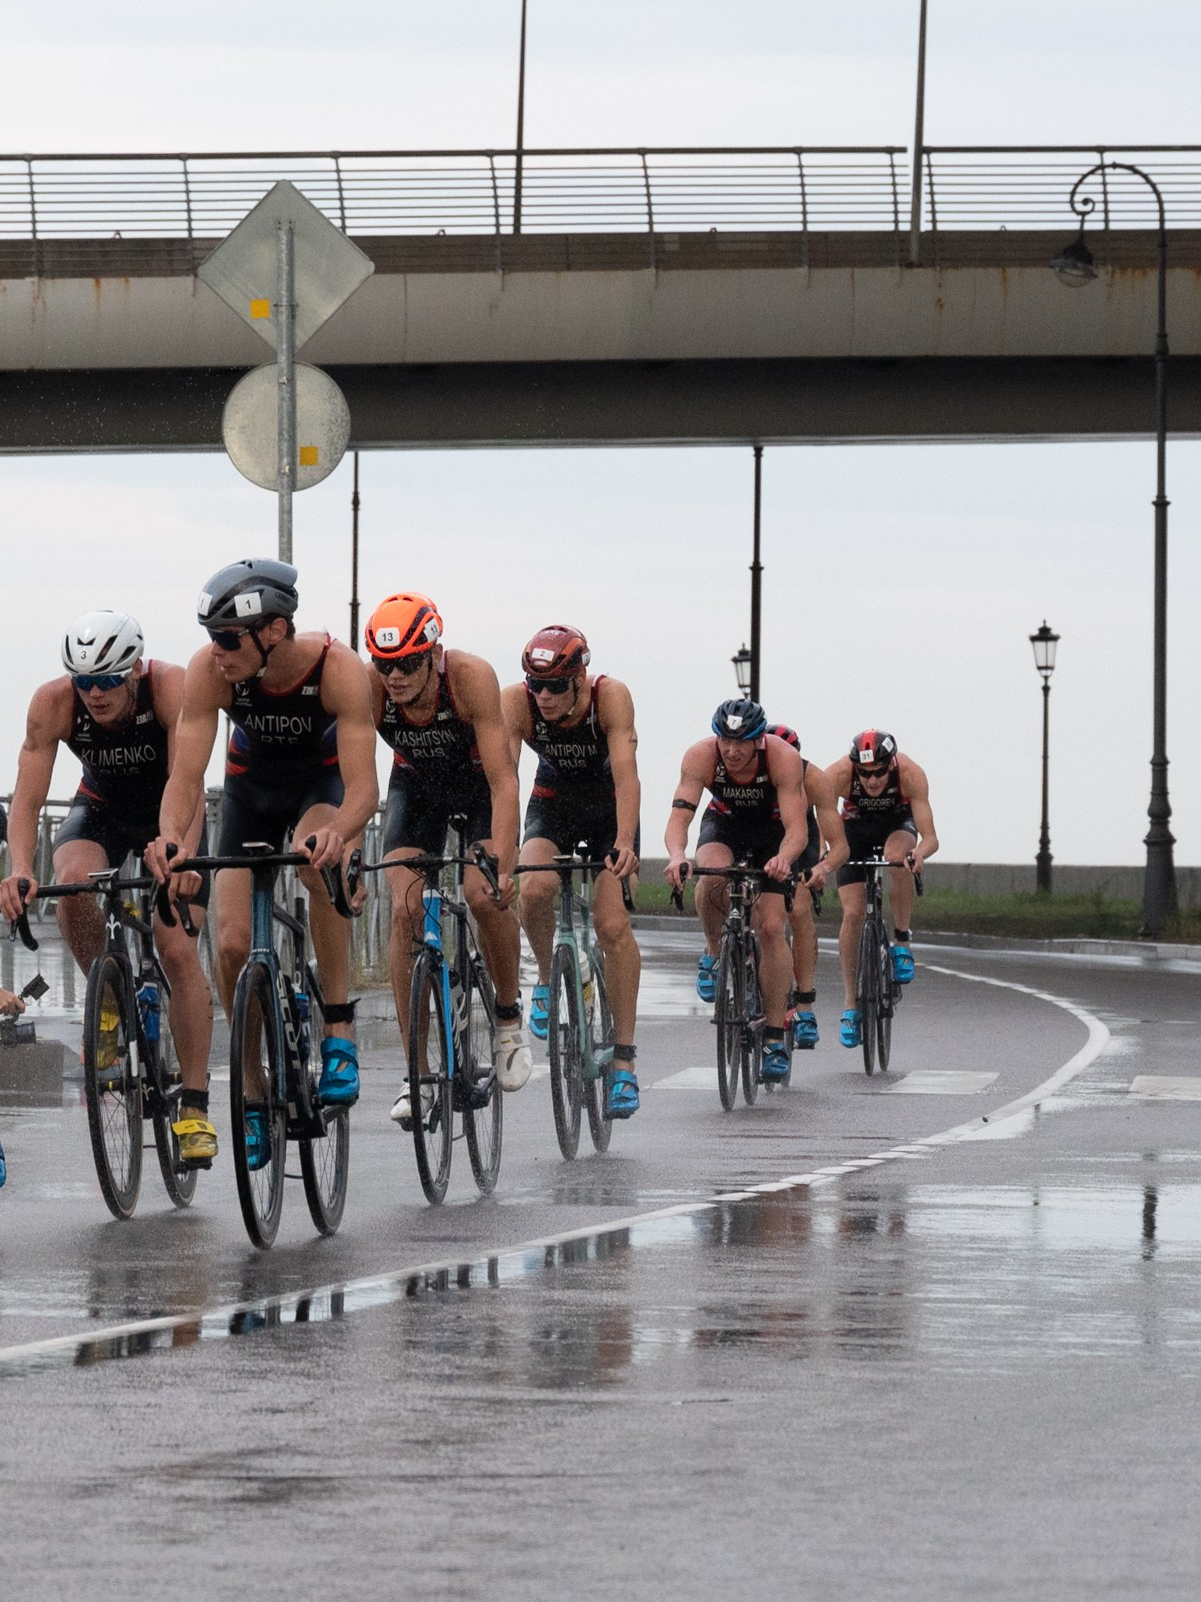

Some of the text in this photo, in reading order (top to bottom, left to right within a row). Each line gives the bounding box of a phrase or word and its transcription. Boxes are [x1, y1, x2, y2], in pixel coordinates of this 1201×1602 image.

[245, 599, 252, 610] 1
[381, 632, 394, 642] 13
[80, 650, 88, 660] 3
[244, 714, 312, 735] ANTIPOV
[394, 729, 456, 747] KASHITSYN
[81, 744, 156, 767] KLIMENKO
[412, 747, 446, 758] RUS
[545, 743, 598, 757] ANTIPOV M
[558, 758, 587, 768] RUS
[723, 787, 764, 799] MAKAROV
